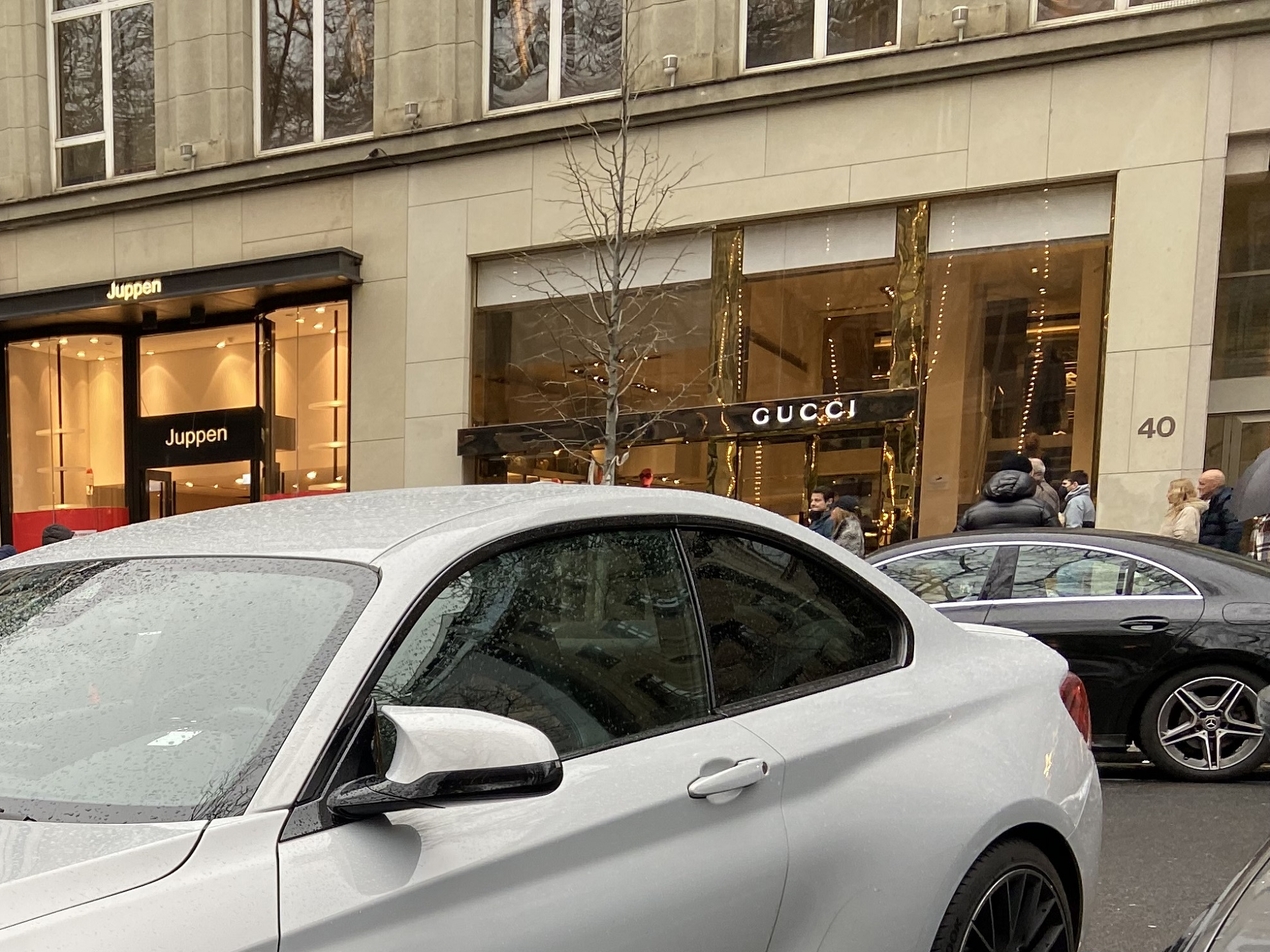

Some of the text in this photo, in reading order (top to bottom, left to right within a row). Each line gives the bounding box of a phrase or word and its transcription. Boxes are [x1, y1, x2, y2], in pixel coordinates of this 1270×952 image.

[106, 279, 162, 301] Juppen
[752, 400, 856, 425] GUCCI
[165, 427, 228, 449] Juppen
[1137, 415, 1176, 439] 40
